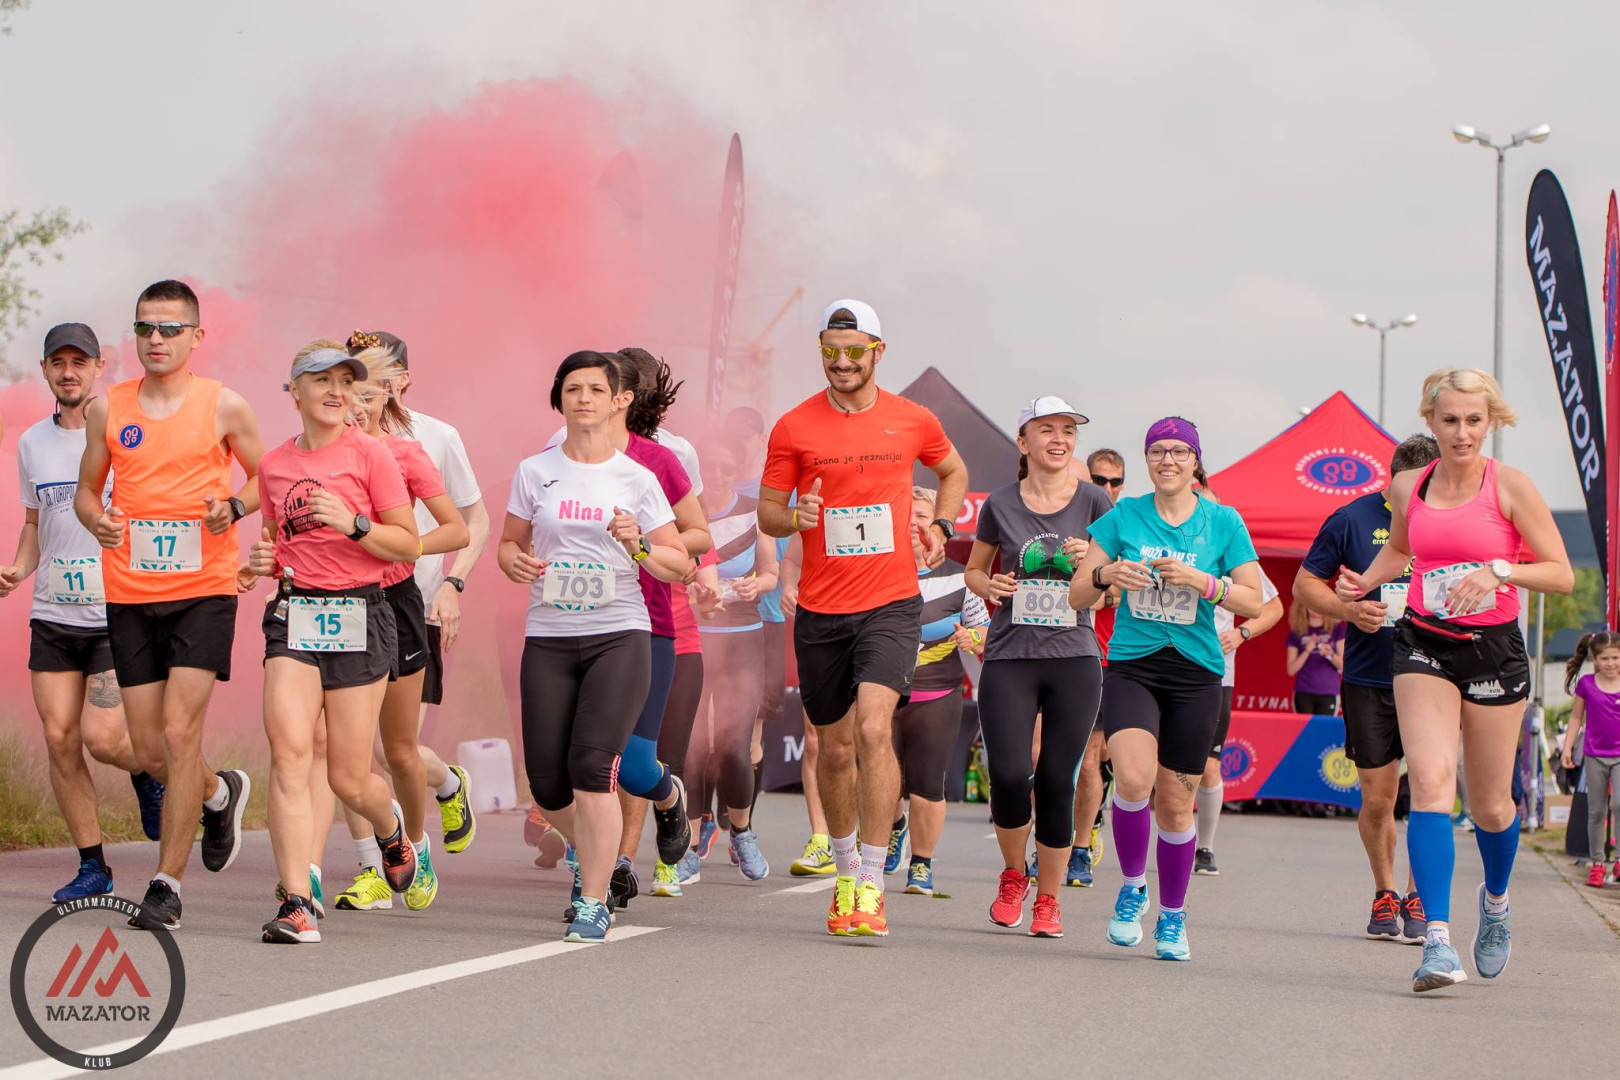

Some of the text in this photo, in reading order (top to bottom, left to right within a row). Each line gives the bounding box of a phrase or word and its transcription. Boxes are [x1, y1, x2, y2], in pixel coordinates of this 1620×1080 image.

[1529, 214, 1601, 492] MAZATOR
[813, 457, 839, 466] Ivana
[844, 454, 854, 464] je
[558, 499, 603, 522] Nina
[855, 522, 865, 541] 1
[1034, 532, 1060, 541] MAZATOR
[152, 535, 177, 557] 17
[1185, 552, 1198, 567] SE
[63, 571, 85, 592] 11
[557, 575, 604, 599] 703
[1024, 592, 1070, 614] 804
[1138, 585, 1192, 611] 1102
[314, 613, 342, 636] 15
